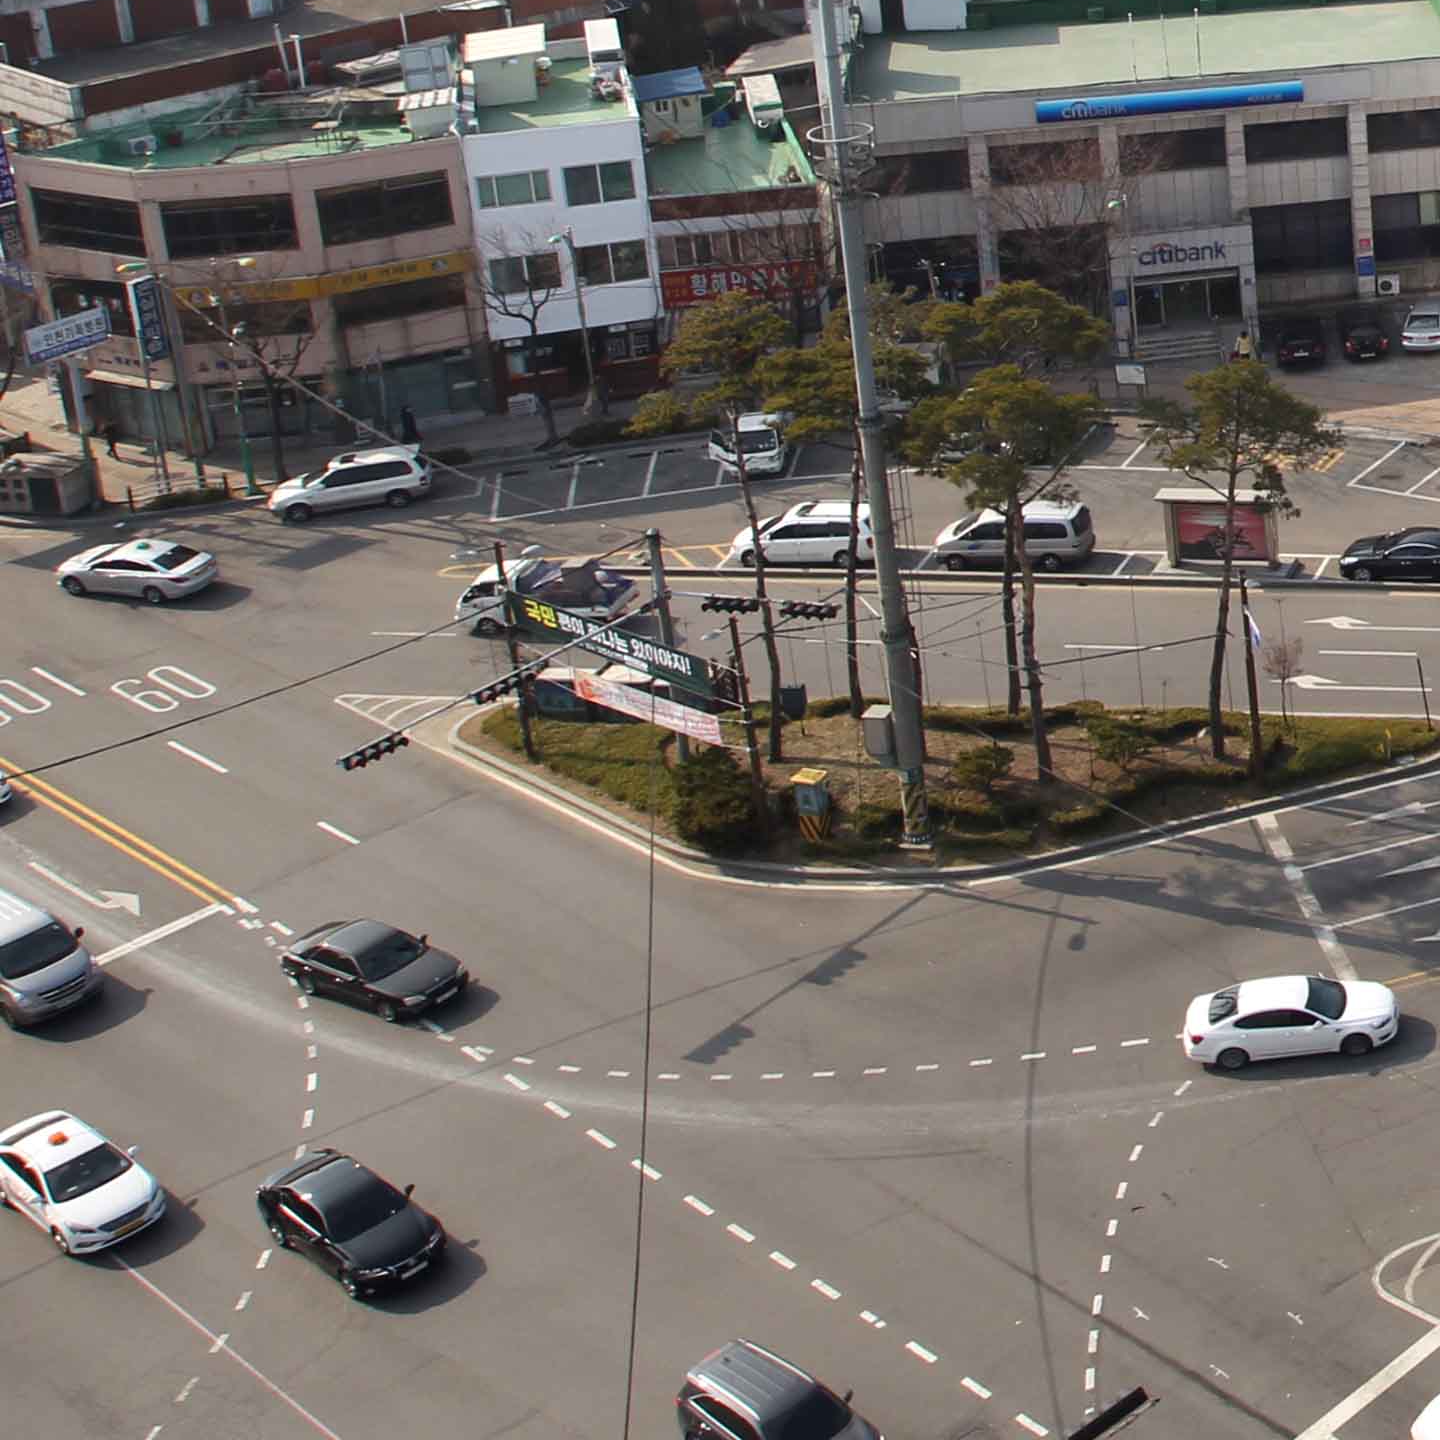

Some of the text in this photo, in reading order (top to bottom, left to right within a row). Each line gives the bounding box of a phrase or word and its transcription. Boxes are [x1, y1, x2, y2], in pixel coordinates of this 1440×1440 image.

[1062, 100, 1127, 118] citibank
[1138, 240, 1226, 266] citibank
[524, 599, 557, 628] 국민
[110, 665, 217, 713] 60
